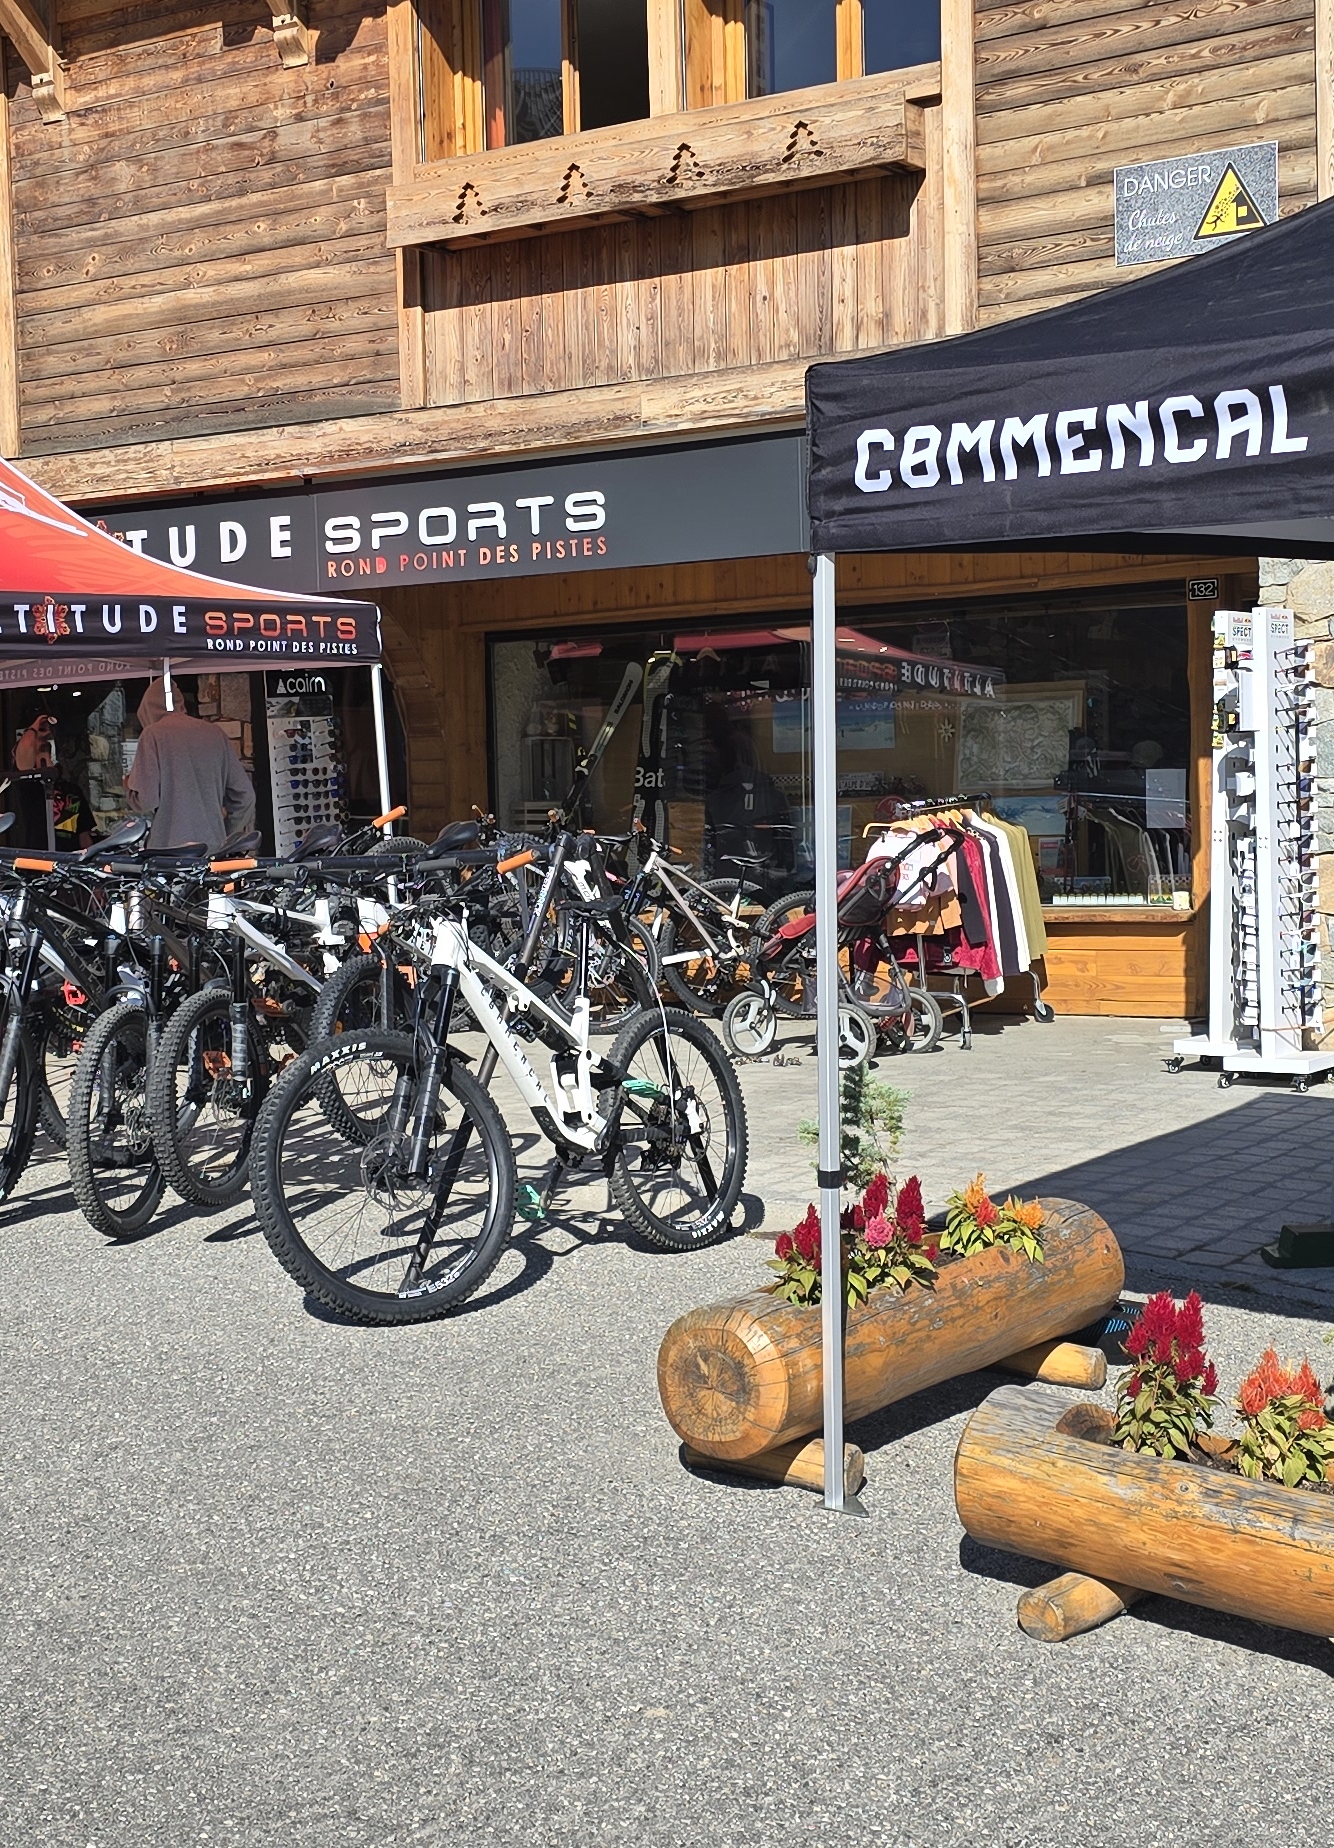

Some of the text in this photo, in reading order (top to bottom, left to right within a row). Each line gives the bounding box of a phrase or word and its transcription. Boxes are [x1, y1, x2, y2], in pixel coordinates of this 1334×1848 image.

[1123, 165, 1212, 197] DANGER
[1128, 209, 1178, 231] Chutes
[1124, 231, 1184, 253] de neige
[854, 384, 1309, 493] COMMENCAL
[126, 490, 607, 568] TUDE SPORTS
[326, 535, 608, 579] ROND POINT DES PISTES
[1193, 583, 1214, 596] 132
[203, 610, 357, 641] SPORTS
[206, 638, 359, 656] ROND POINT DES PISTES
[286, 673, 326, 694] cairn
[310, 1041, 367, 1076] MAXXIS
